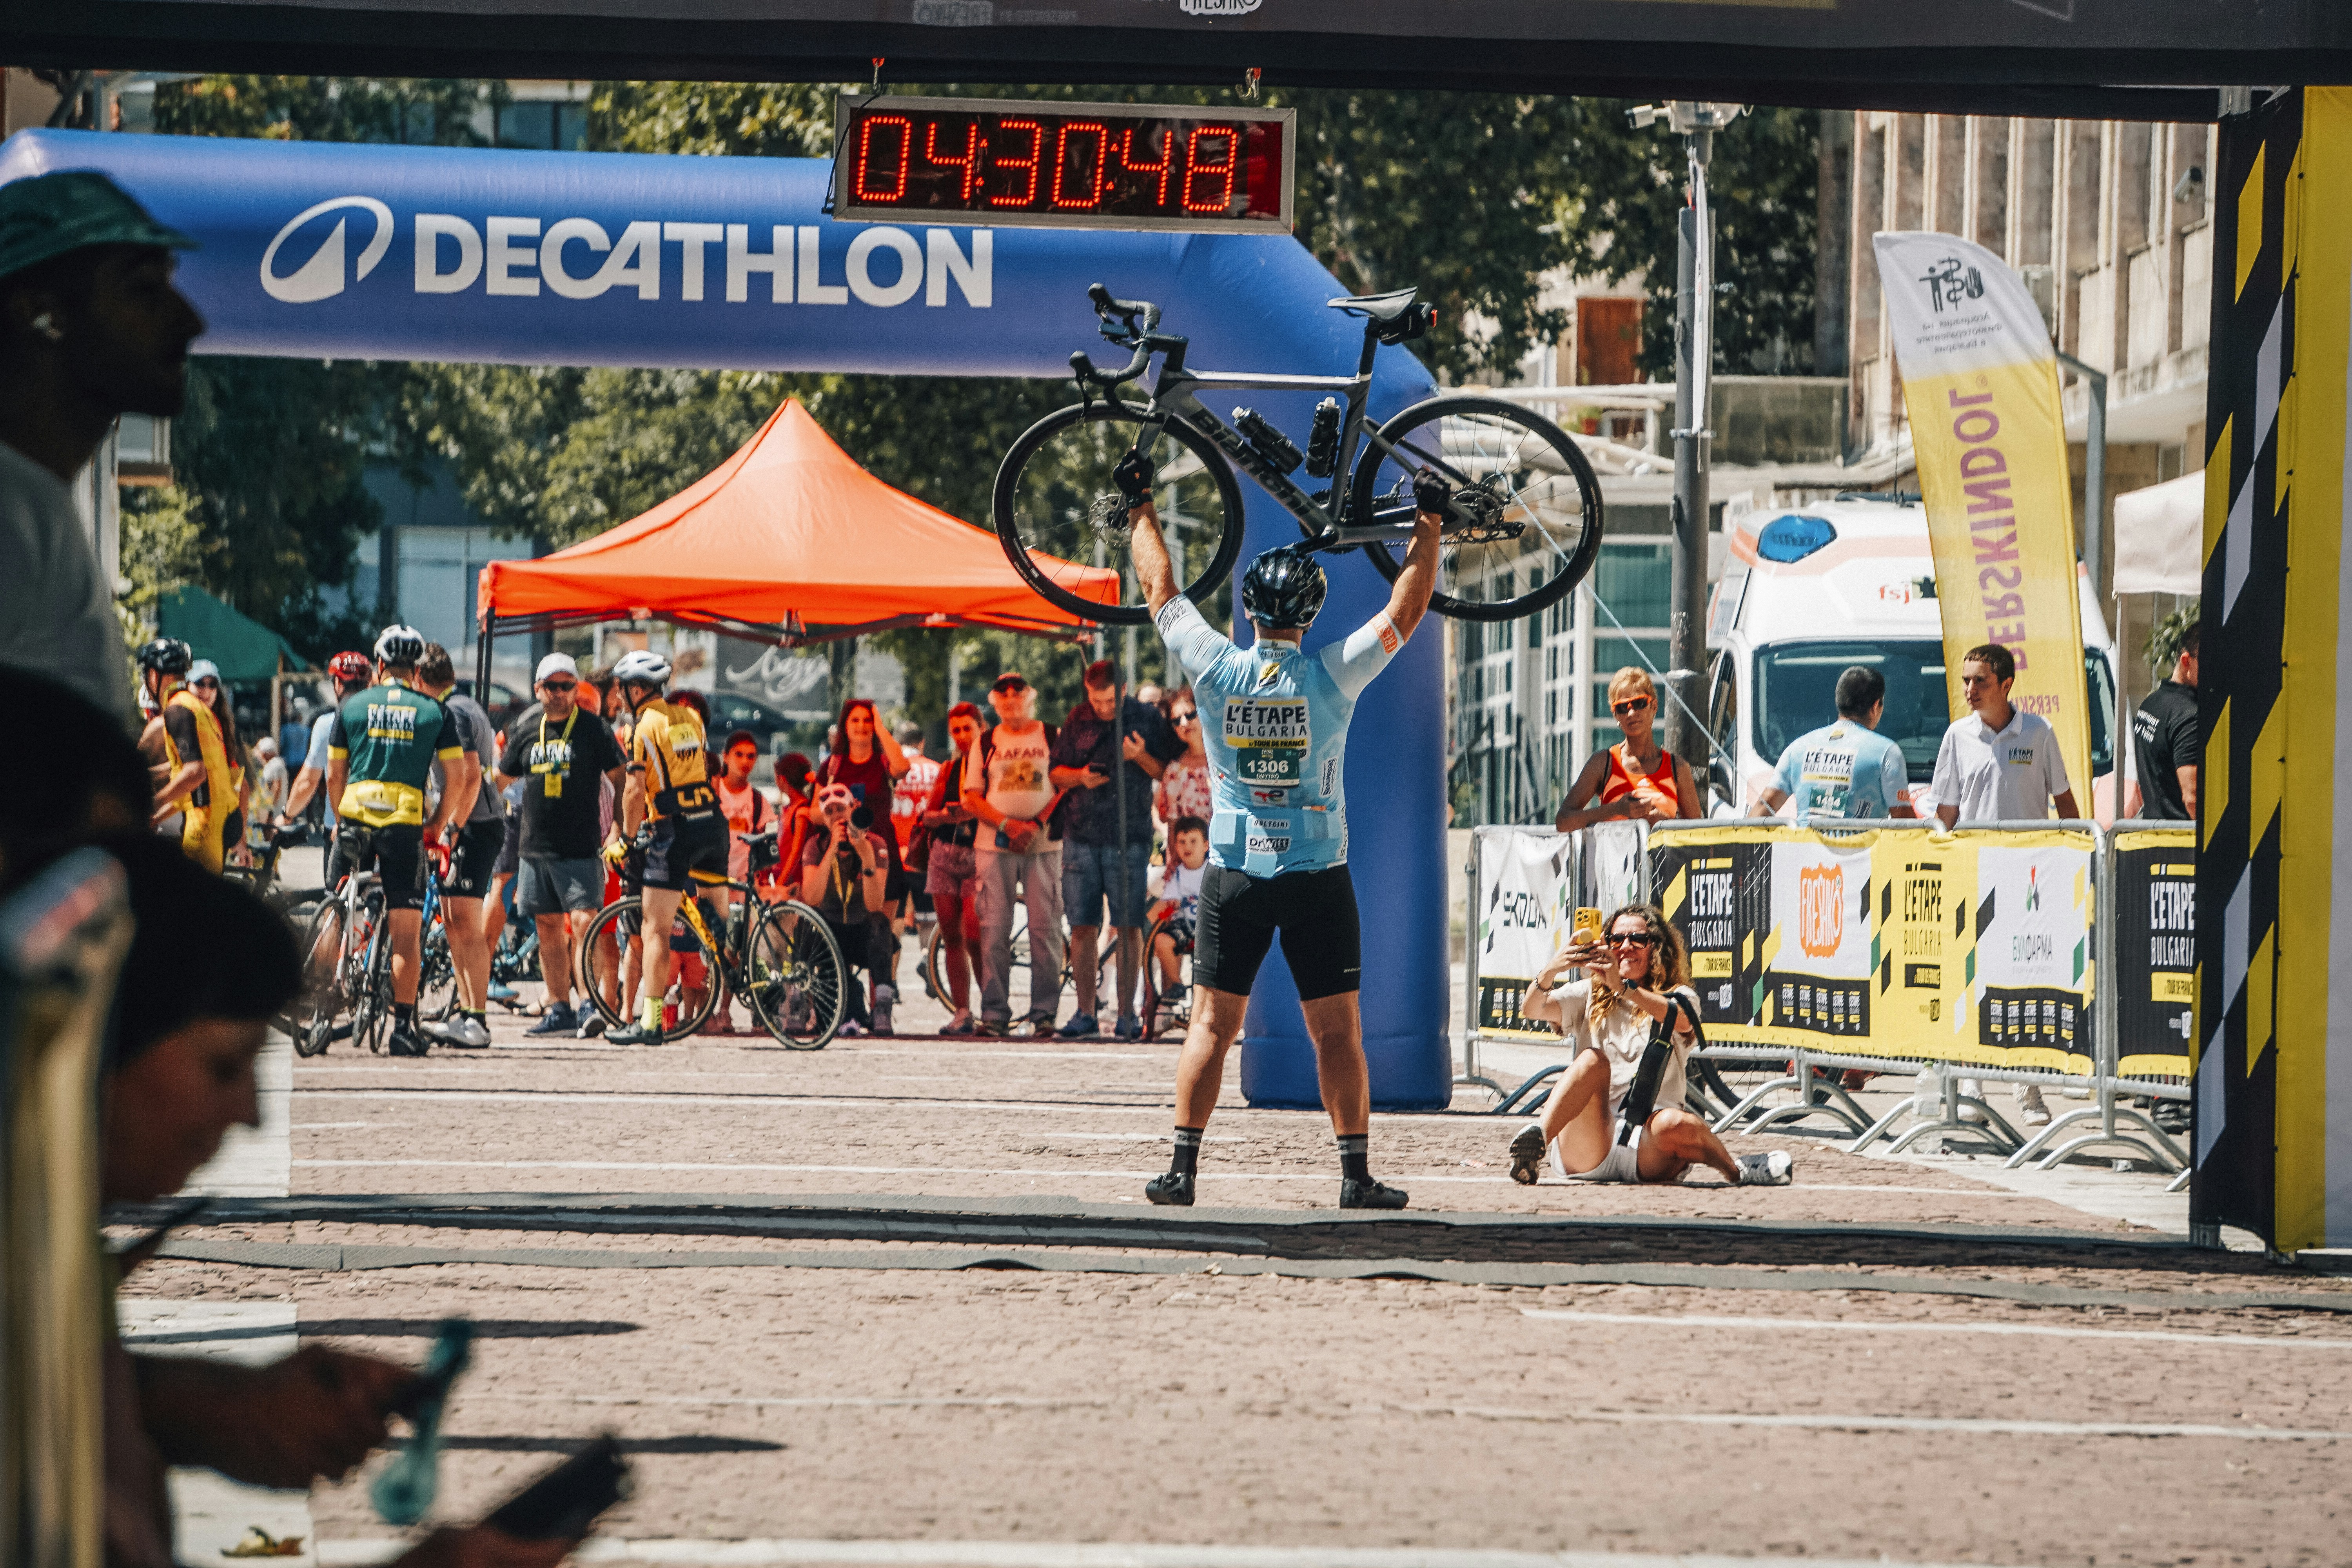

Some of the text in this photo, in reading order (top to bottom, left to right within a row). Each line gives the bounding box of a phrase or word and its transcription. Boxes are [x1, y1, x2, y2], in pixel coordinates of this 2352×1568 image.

[857, 117, 1237, 212] 04:30:48
[415, 213, 993, 308] DECATHLON
[1226, 700, 1306, 724] L'ÉTAPE
[1226, 723, 1307, 737] BULGARIA
[1247, 760, 1289, 773] 1306
[1691, 920, 1733, 947] BULGARIA
[1904, 929, 1942, 956] BULGARIA
